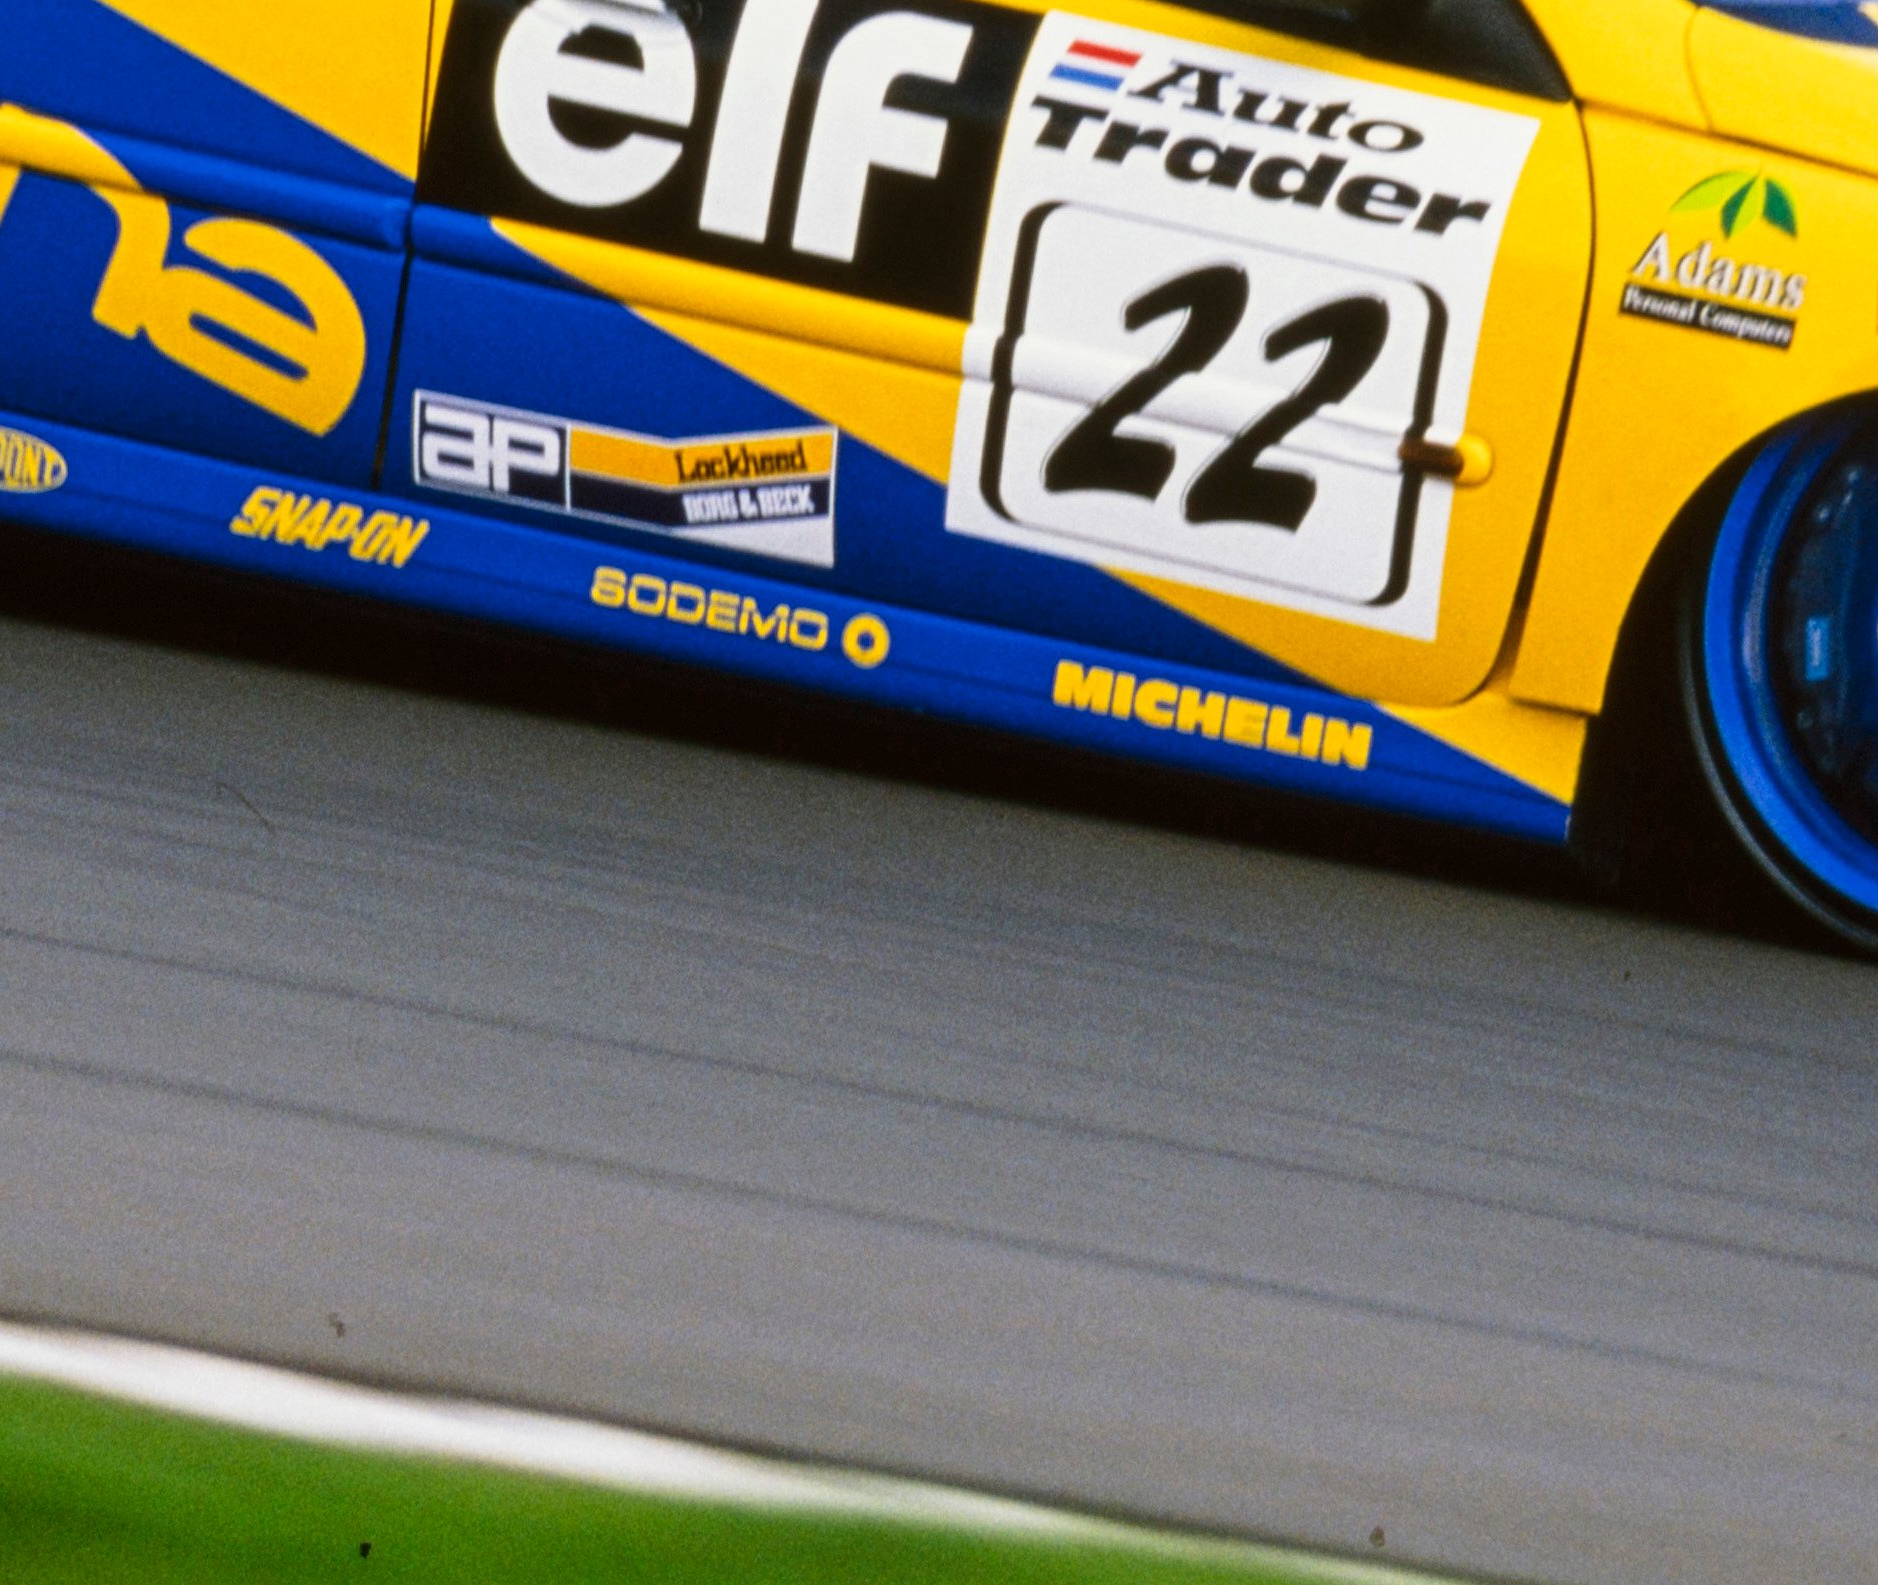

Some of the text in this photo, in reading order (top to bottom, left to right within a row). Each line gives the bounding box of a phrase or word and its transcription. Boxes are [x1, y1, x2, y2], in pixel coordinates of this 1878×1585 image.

[1127, 58, 1426, 155] Auto
[1029, 99, 1492, 238] Trader
[1624, 284, 1697, 323] Personal
[1630, 229, 1808, 312] Adams
[1043, 262, 1389, 535] 22
[590, 565, 829, 652] SODEMO
[1052, 660, 1372, 771] MICHELIN
